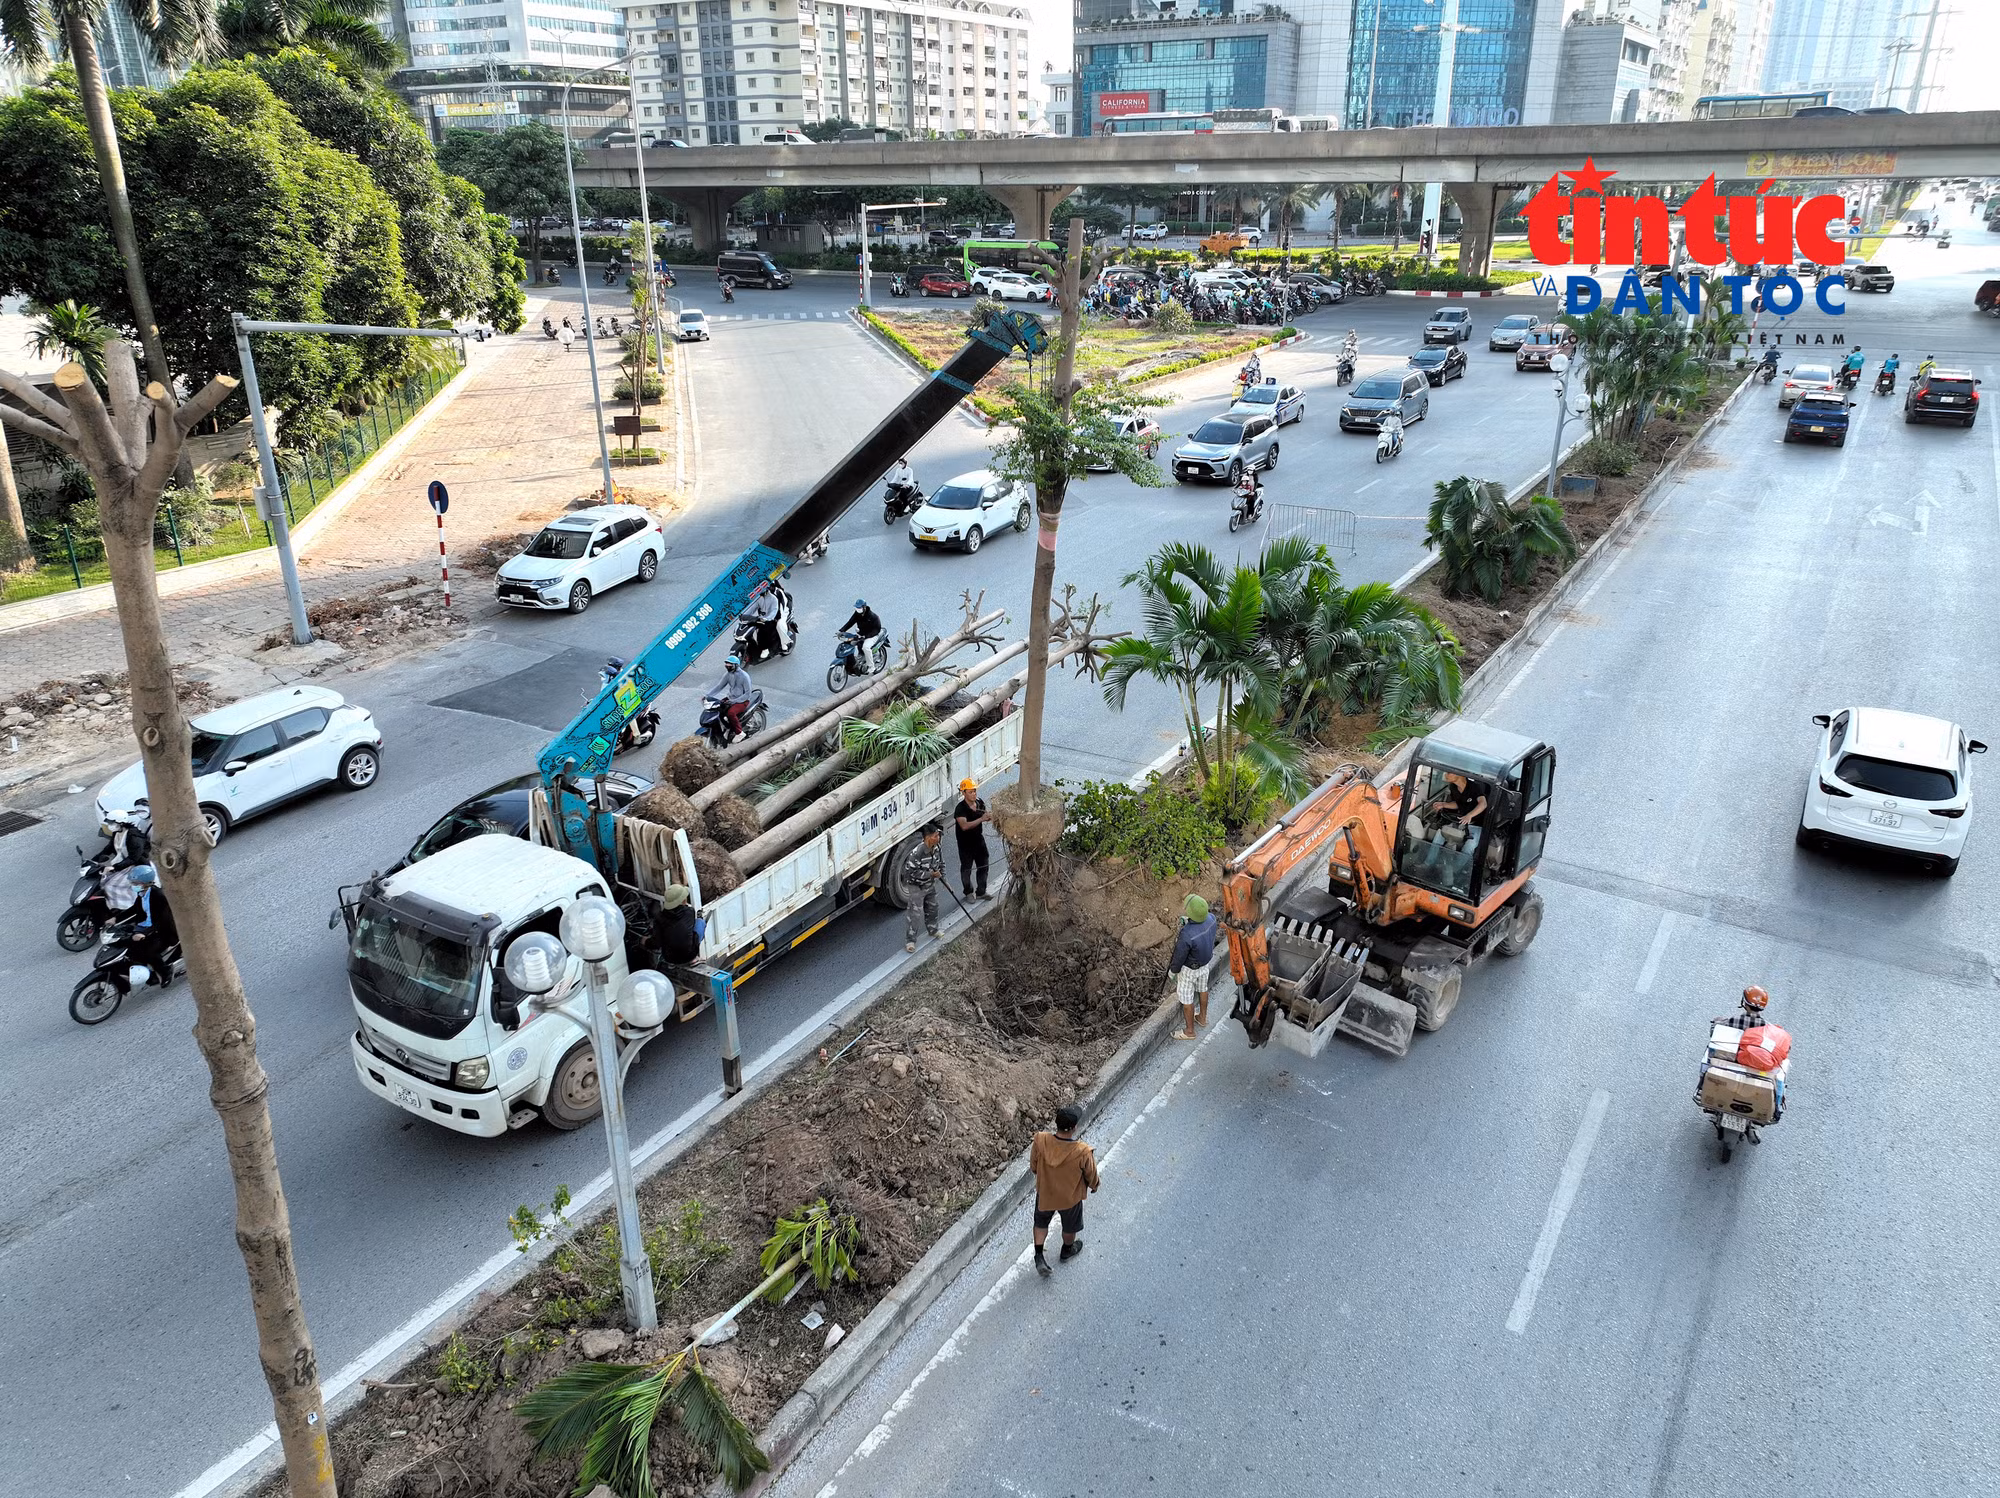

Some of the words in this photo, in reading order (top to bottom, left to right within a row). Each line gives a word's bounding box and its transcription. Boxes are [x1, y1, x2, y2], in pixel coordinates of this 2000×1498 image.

[1412, 106, 1520, 127] HNDICO
[736, 553, 759, 578] TADANO
[665, 629, 687, 650] 0988
[681, 616, 700, 633] 392
[695, 603, 713, 621] 368
[1291, 819, 1331, 861] DAEWOO
